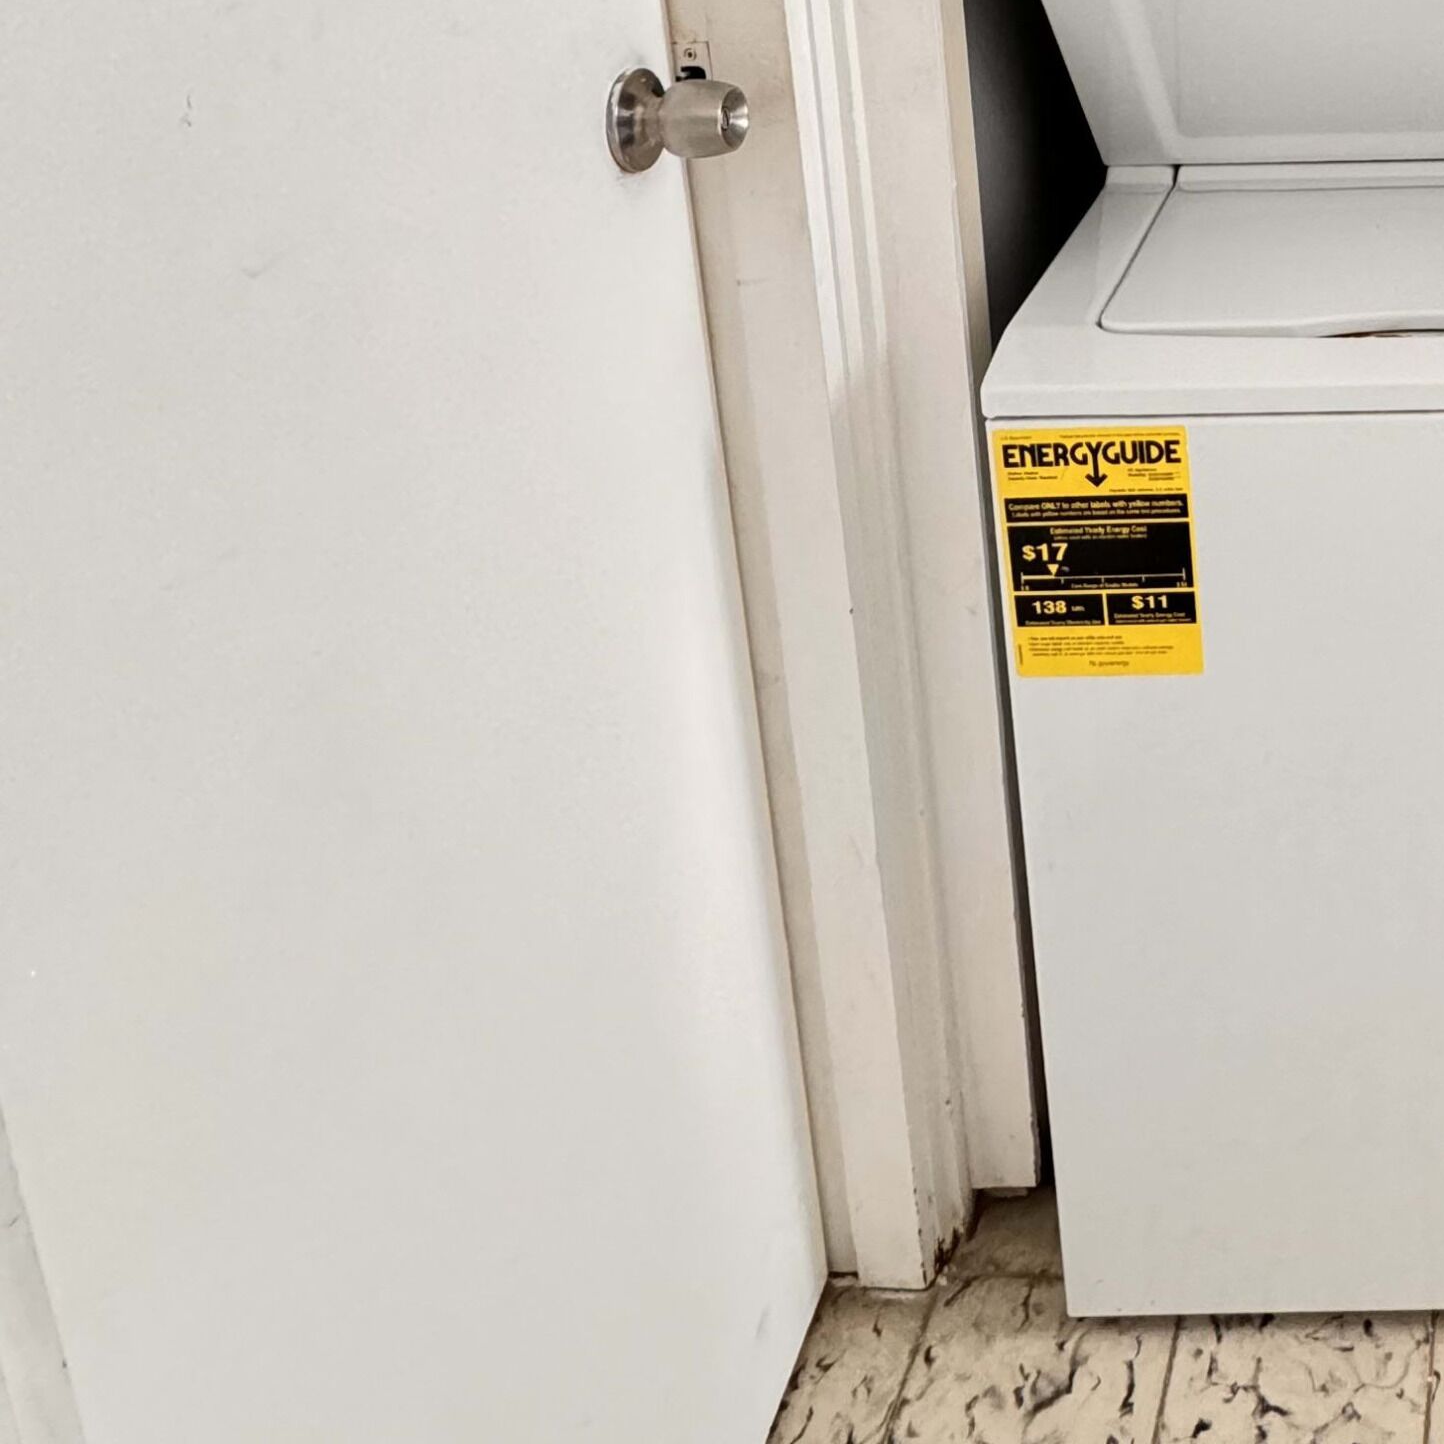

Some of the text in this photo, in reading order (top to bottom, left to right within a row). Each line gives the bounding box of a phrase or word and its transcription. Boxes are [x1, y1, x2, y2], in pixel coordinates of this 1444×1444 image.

[1002, 439, 1181, 468] ENERGYGUIDE
[1008, 503, 1040, 511] Compare
[1041, 502, 1061, 510] ONLY
[1112, 500, 1127, 508] with
[1128, 500, 1150, 508] yellow
[1050, 527, 1084, 535] Estimated
[1085, 526, 1105, 535] Yearly
[1106, 526, 1130, 534] Energy
[1022, 542, 1068, 561] $17
[1032, 600, 1067, 614] 138
[1131, 594, 1168, 609] $11
